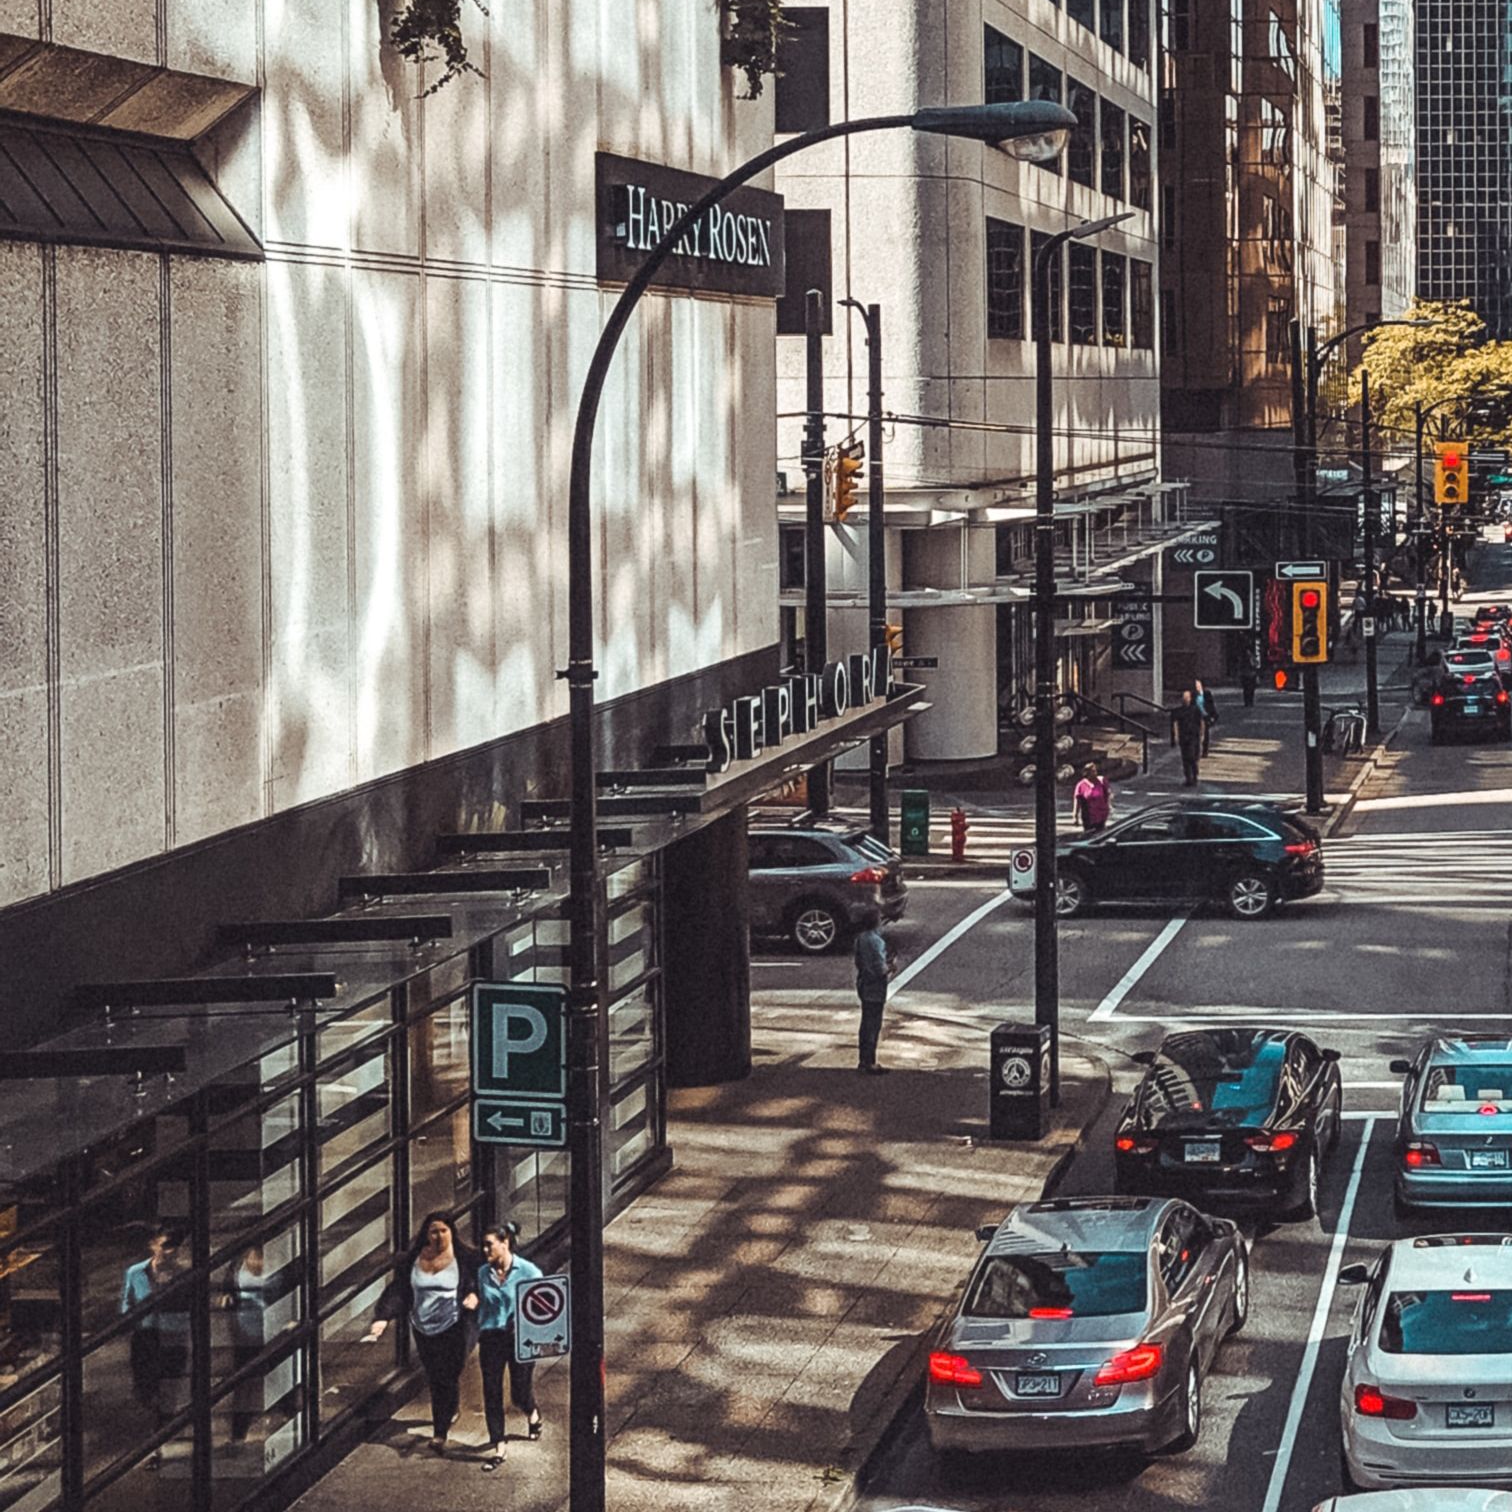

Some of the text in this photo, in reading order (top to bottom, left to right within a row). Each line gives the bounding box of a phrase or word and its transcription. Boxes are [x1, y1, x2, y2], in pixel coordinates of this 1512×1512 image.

[626, 184, 771, 267] HARRY ROSEN
[1179, 534, 1217, 545] ARKING
[703, 643, 896, 773] SEPHORA
[492, 1003, 548, 1079] P
